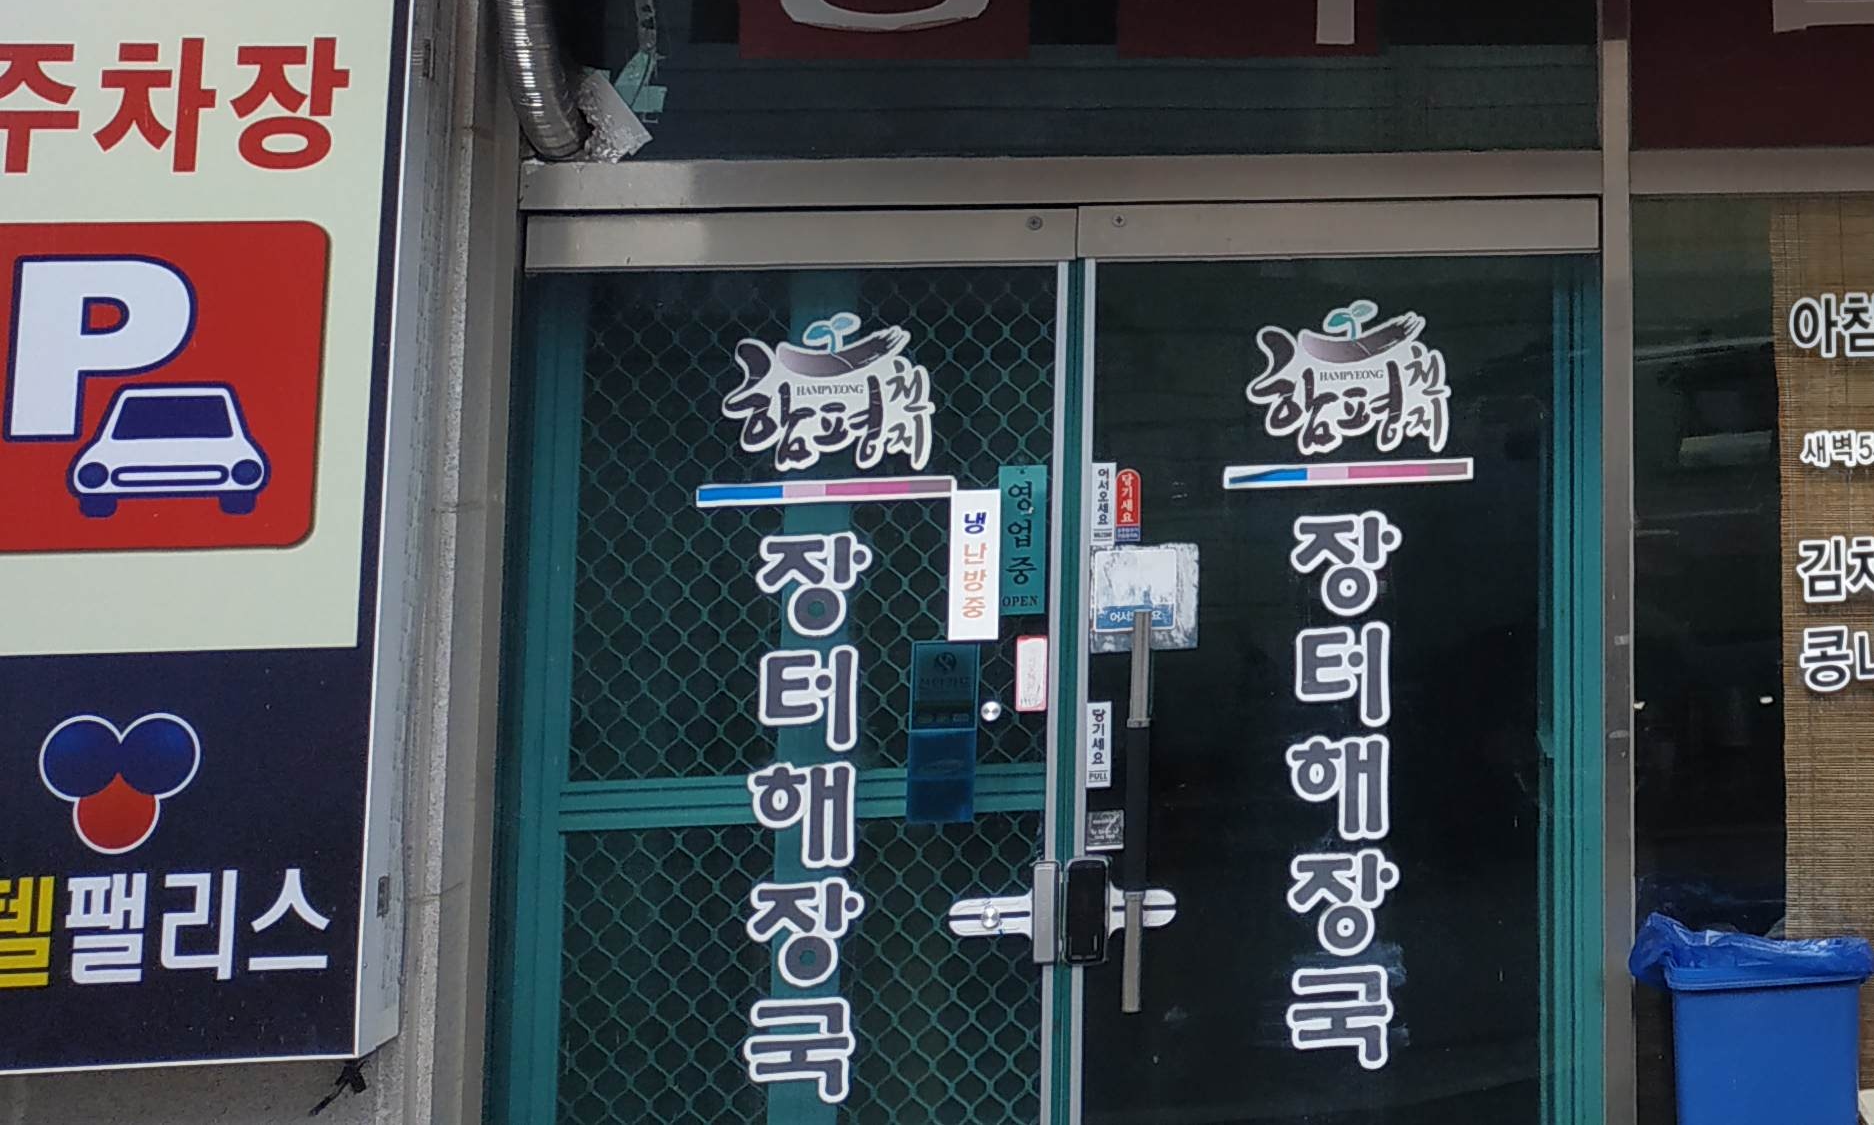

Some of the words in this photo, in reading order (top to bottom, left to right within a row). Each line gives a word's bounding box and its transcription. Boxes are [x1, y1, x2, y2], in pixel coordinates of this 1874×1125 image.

[0, 36, 351, 174] 주차장
[4, 254, 198, 442] P
[1319, 368, 1384, 382] HAMPYEONG
[796, 383, 864, 397] HAMPYEONG
[1097, 467, 1110, 525] 어서오세요
[1120, 473, 1135, 523] 당기세요
[1005, 481, 1037, 585] 영업중
[1002, 594, 1038, 607] OPEN
[1091, 708, 1106, 765] 당기세요
[744, 530, 873, 1105] 장터해장국
[1286, 509, 1402, 1070] 장터해장국
